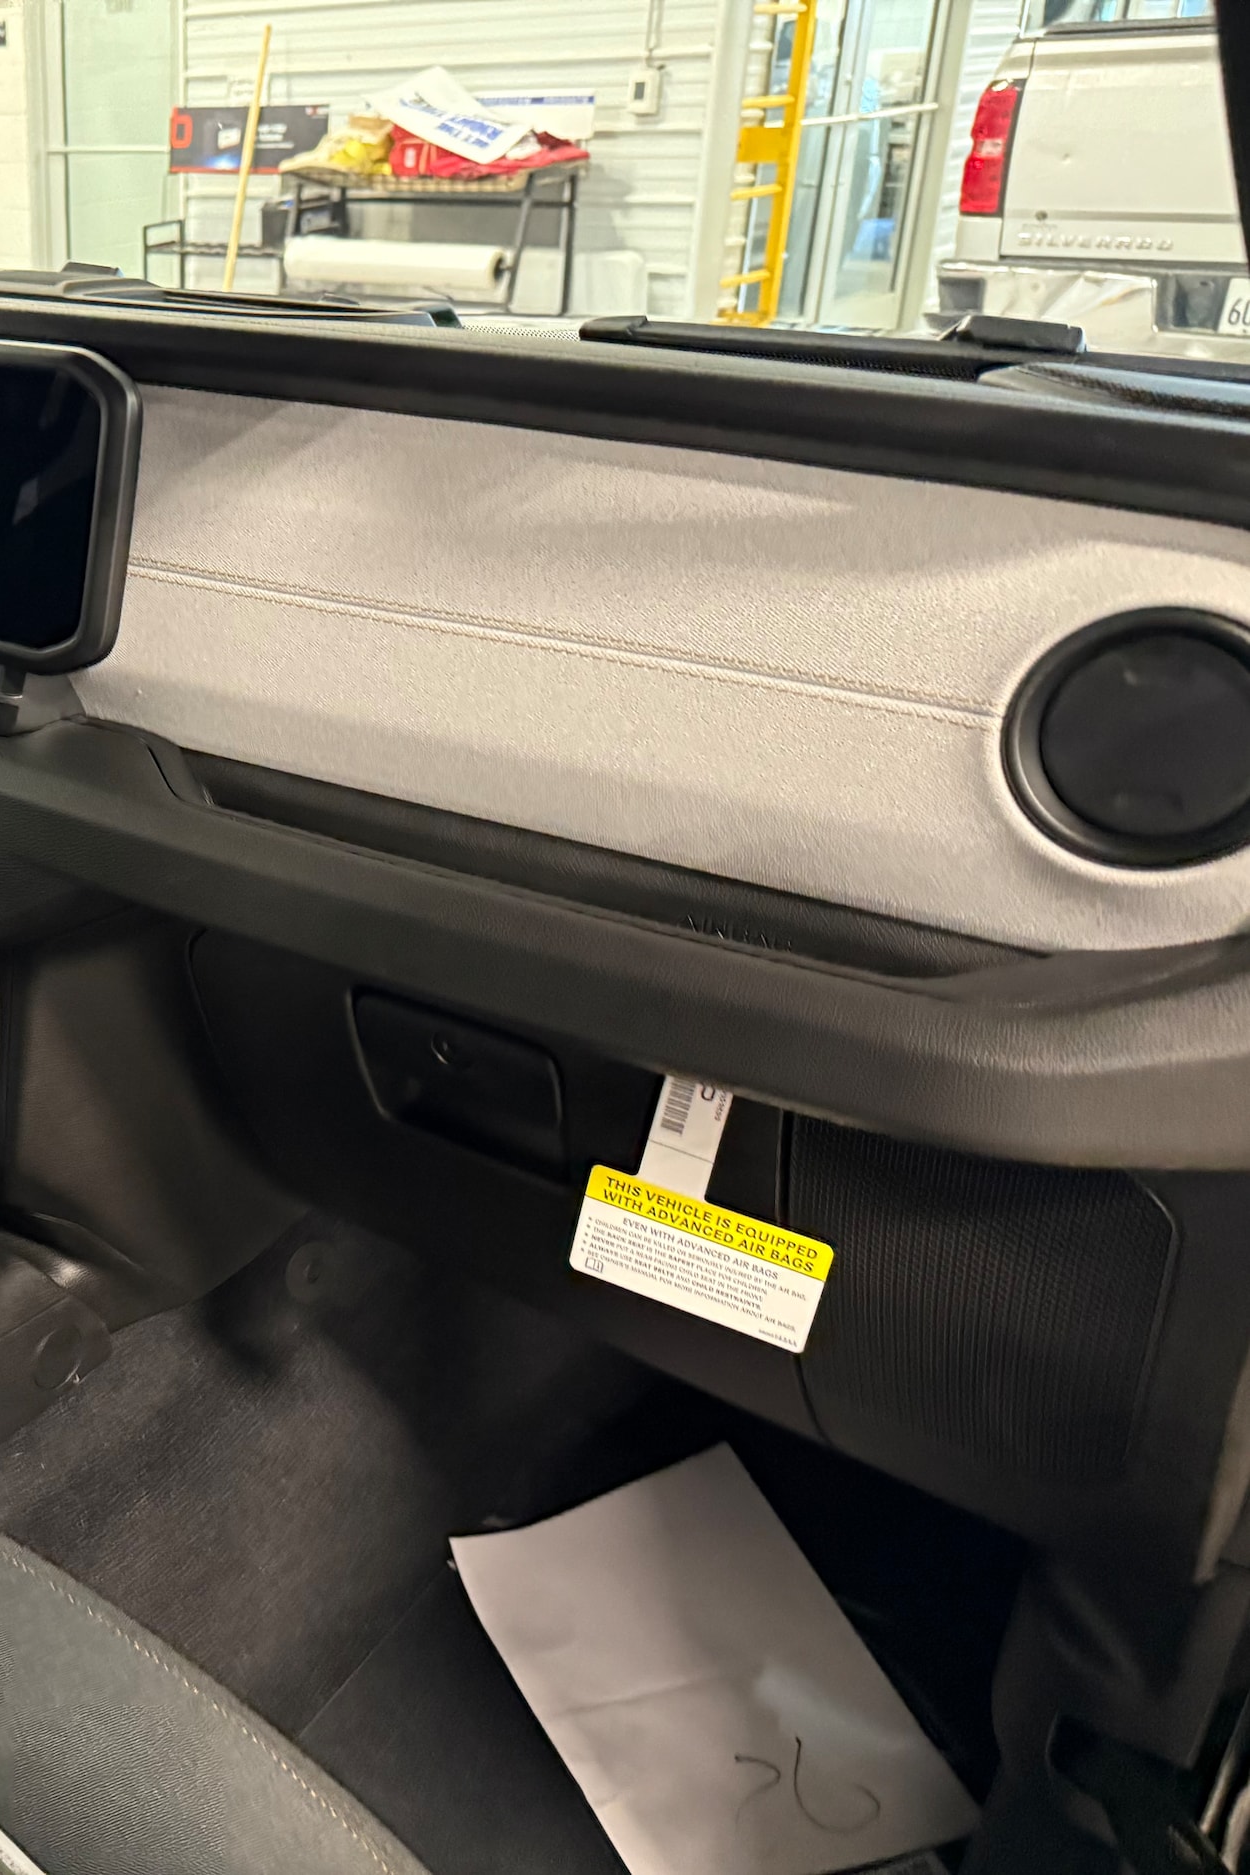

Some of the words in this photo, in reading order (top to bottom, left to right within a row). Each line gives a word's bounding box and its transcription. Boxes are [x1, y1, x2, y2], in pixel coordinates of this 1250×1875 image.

[1017, 232, 1174, 252] SILVERADO
[603, 1189, 642, 1211] WITH
[646, 1206, 733, 1243] ADVANCED
[739, 1239, 765, 1256] AIR
[770, 1249, 813, 1272] BAGS
[607, 1176, 641, 1197] THIS
[646, 1190, 711, 1222] VEHICLE
[715, 1215, 731, 1229] IS
[735, 1223, 817, 1259] EQUIPPED
[622, 1217, 647, 1232] EVEN
[650, 1226, 674, 1242] WITH
[677, 1238, 730, 1261] ADVANCED
[732, 1257, 749, 1269] AIR
[751, 1263, 778, 1279] BAGS
